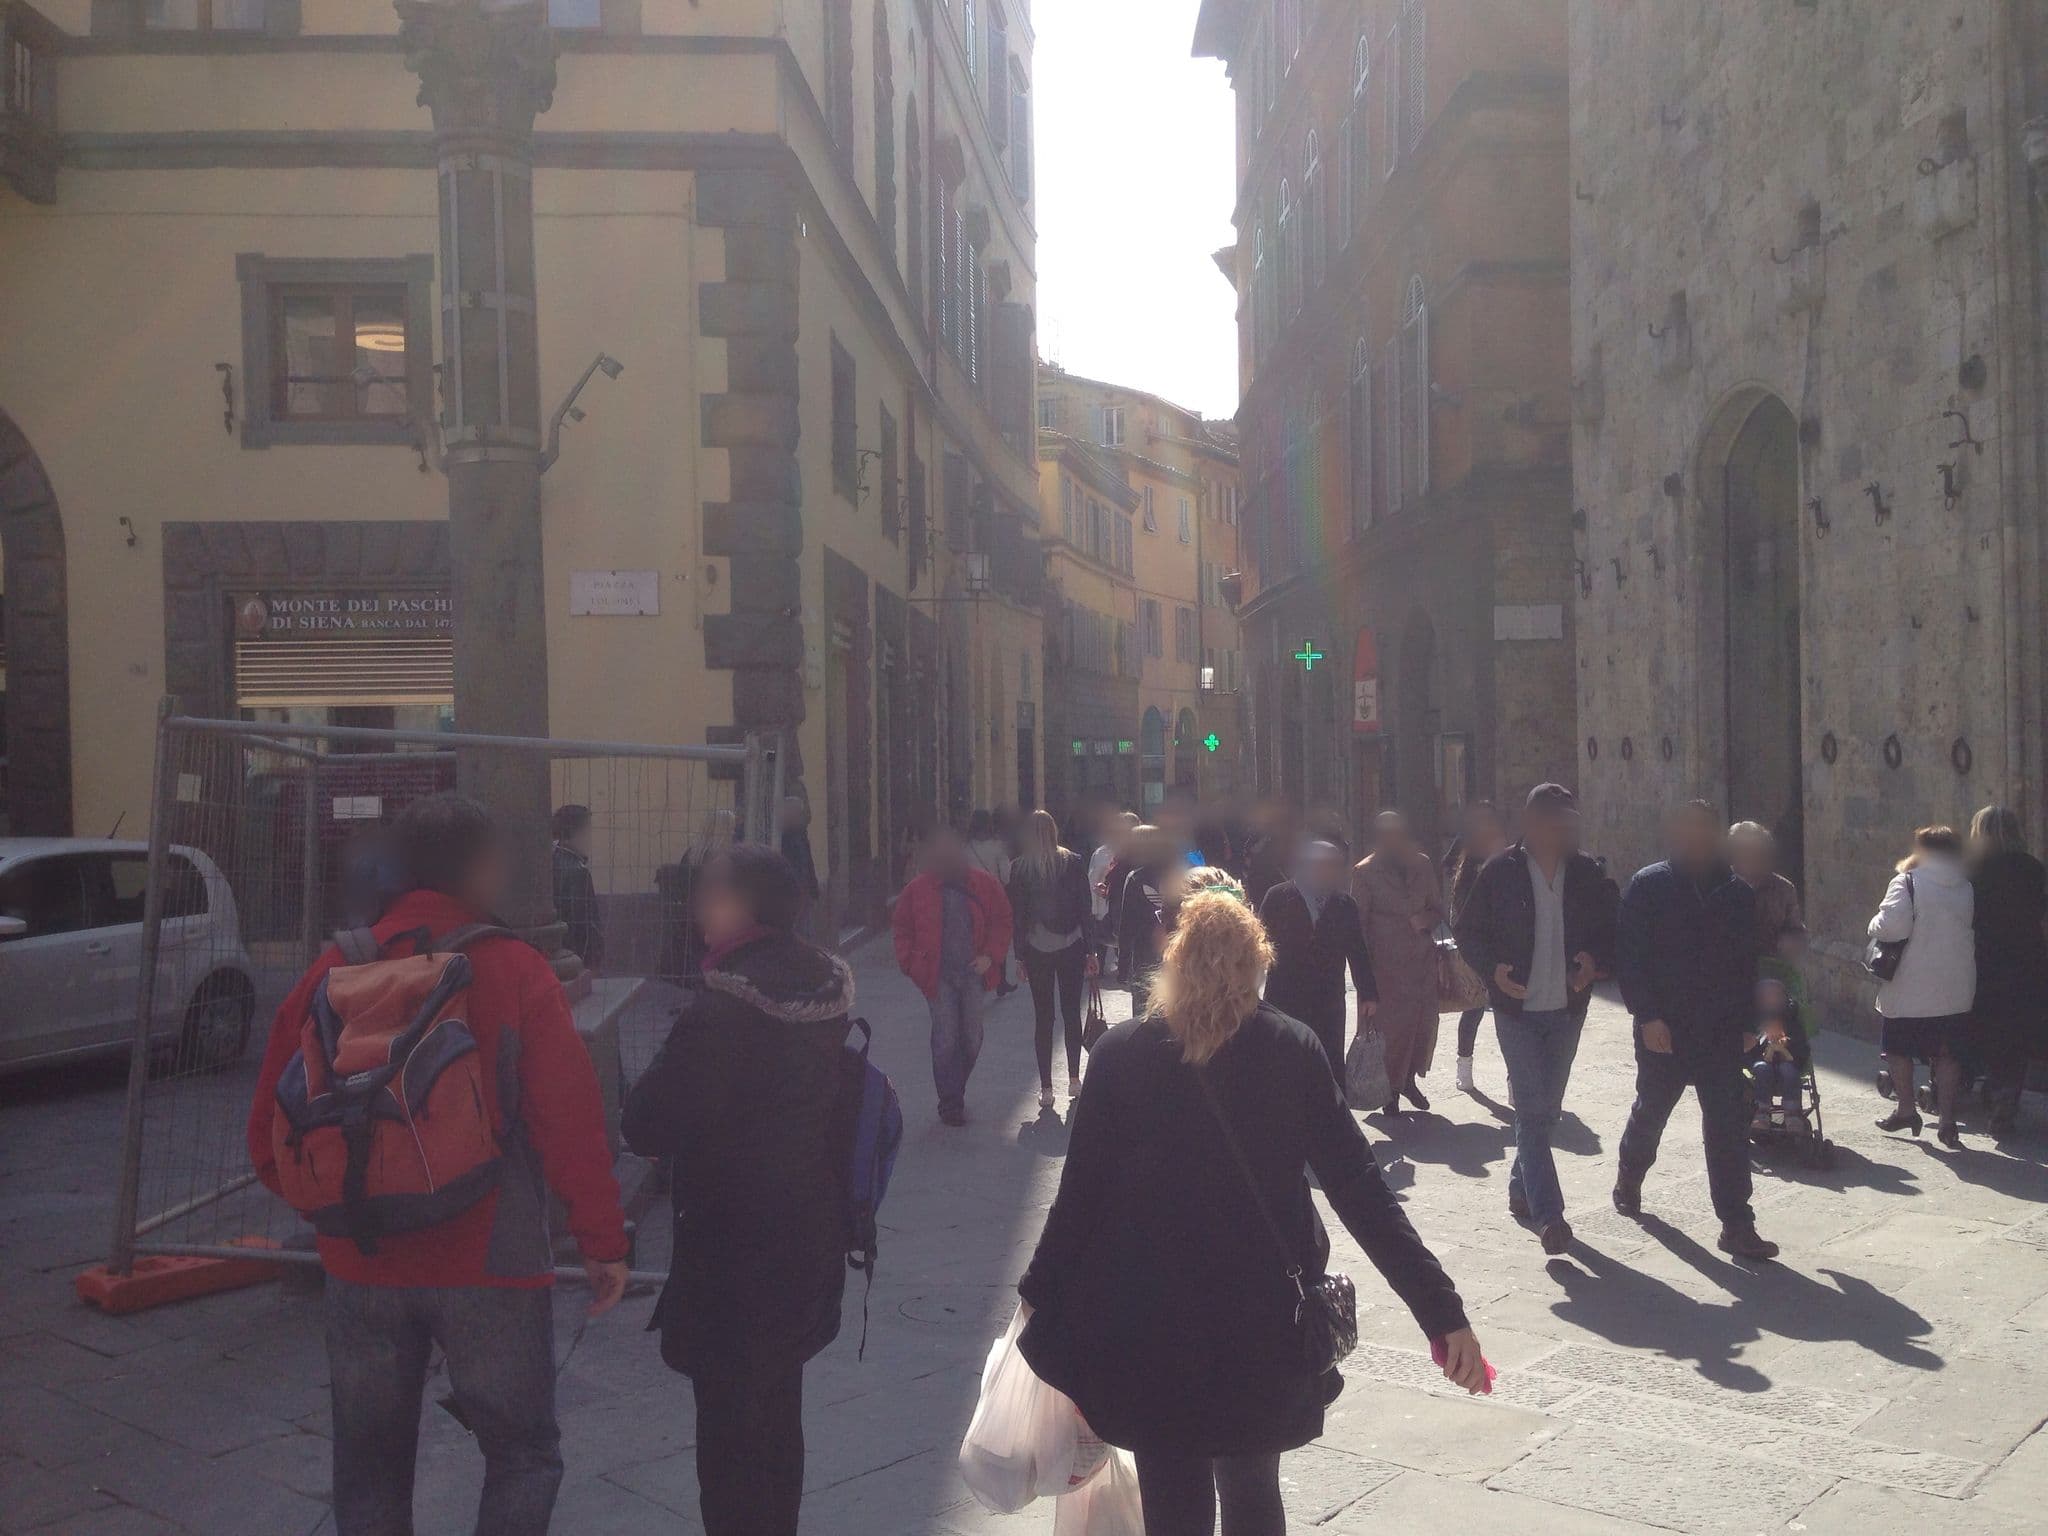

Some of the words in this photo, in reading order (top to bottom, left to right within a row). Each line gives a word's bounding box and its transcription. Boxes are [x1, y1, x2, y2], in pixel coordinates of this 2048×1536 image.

[272, 599, 341, 612] MONTE
[348, 599, 379, 612] DEI
[387, 599, 453, 611] PASCHI
[272, 616, 292, 629] DI
[299, 616, 355, 629] SIENA
[361, 619, 400, 629] BANCA
[405, 619, 427, 629] DAL
[434, 619, 454, 628] 147
